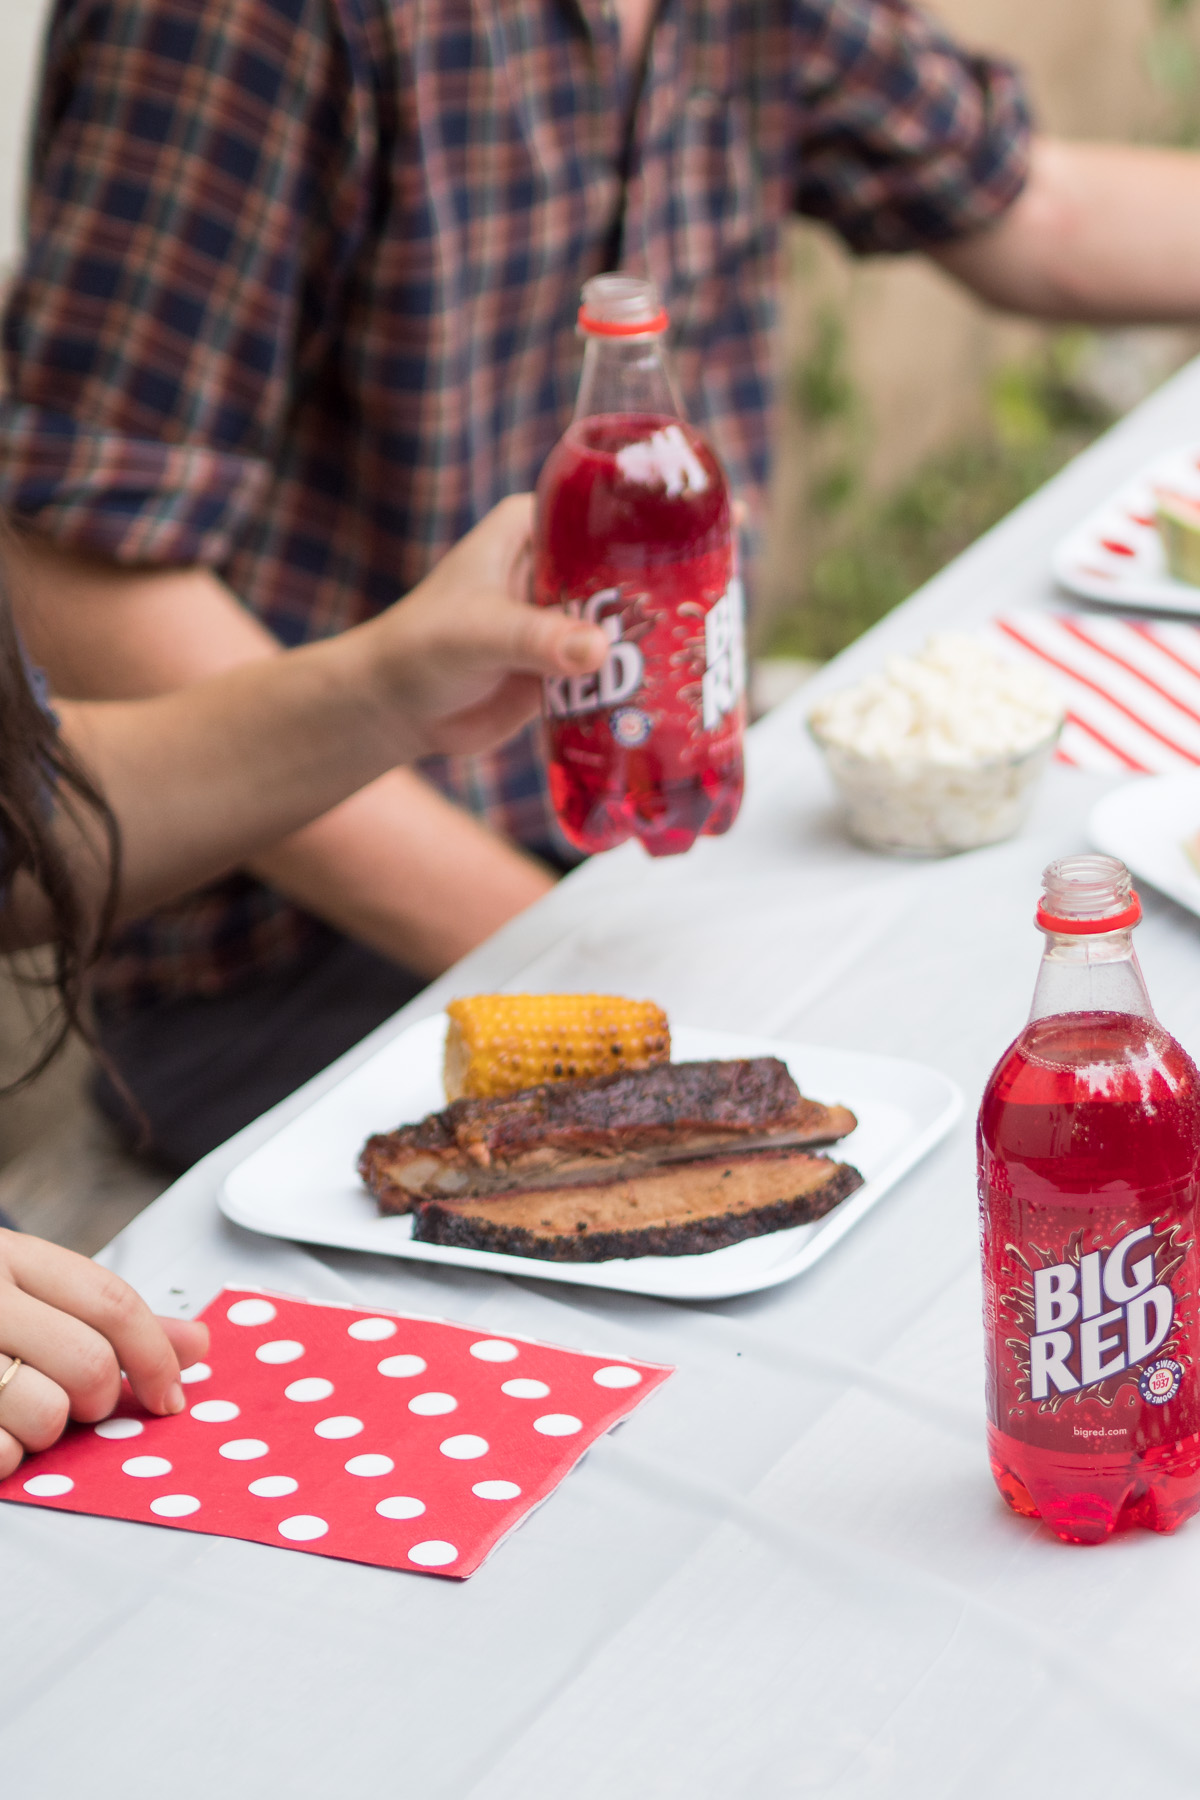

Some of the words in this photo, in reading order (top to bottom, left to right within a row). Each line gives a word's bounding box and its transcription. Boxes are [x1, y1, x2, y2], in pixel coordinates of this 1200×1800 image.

[1032, 1223, 1156, 1335] BIG
[1029, 1283, 1174, 1401] RED
[1143, 1366, 1154, 1378] SO
[1155, 1360, 1179, 1371] SWEET
[1155, 1372, 1166, 1380] EST.
[1152, 1377, 1170, 1390] 1937
[1143, 1390, 1153, 1400] SO
[1151, 1383, 1179, 1404] SMOOTH
[1073, 1426, 1127, 1438] bigred.com
